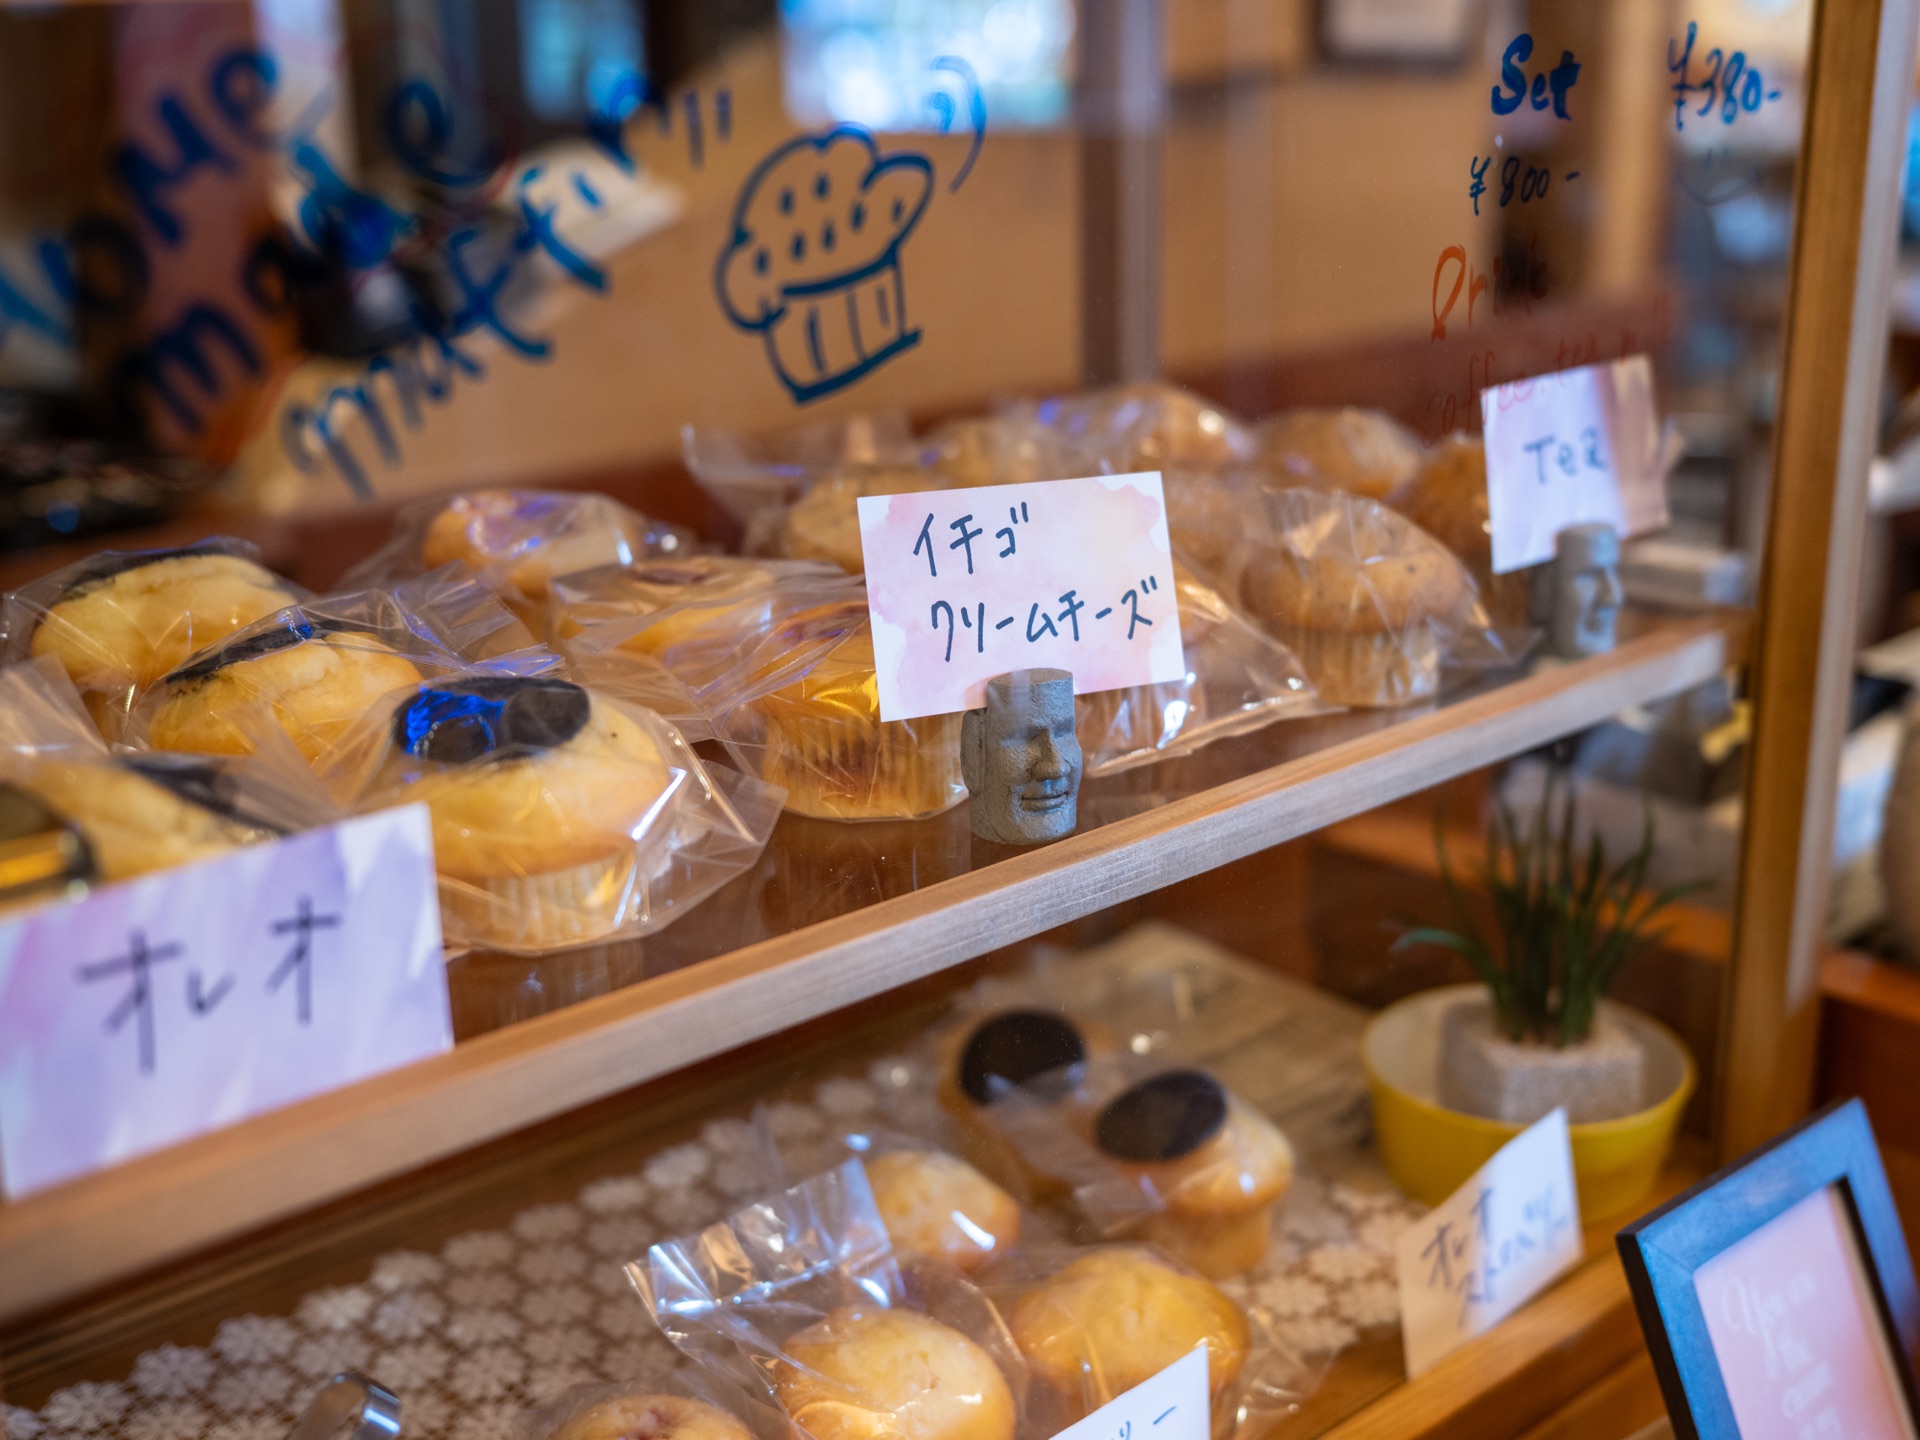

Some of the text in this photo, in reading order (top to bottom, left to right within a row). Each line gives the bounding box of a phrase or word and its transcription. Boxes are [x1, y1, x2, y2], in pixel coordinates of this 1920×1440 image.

[1491, 33, 1581, 122] Set
[1522, 427, 1607, 485] Tea
[912, 501, 1029, 577] イチゴ
[930, 575, 1158, 662] クリームチーズ
[76, 896, 342, 1076] オレオ
